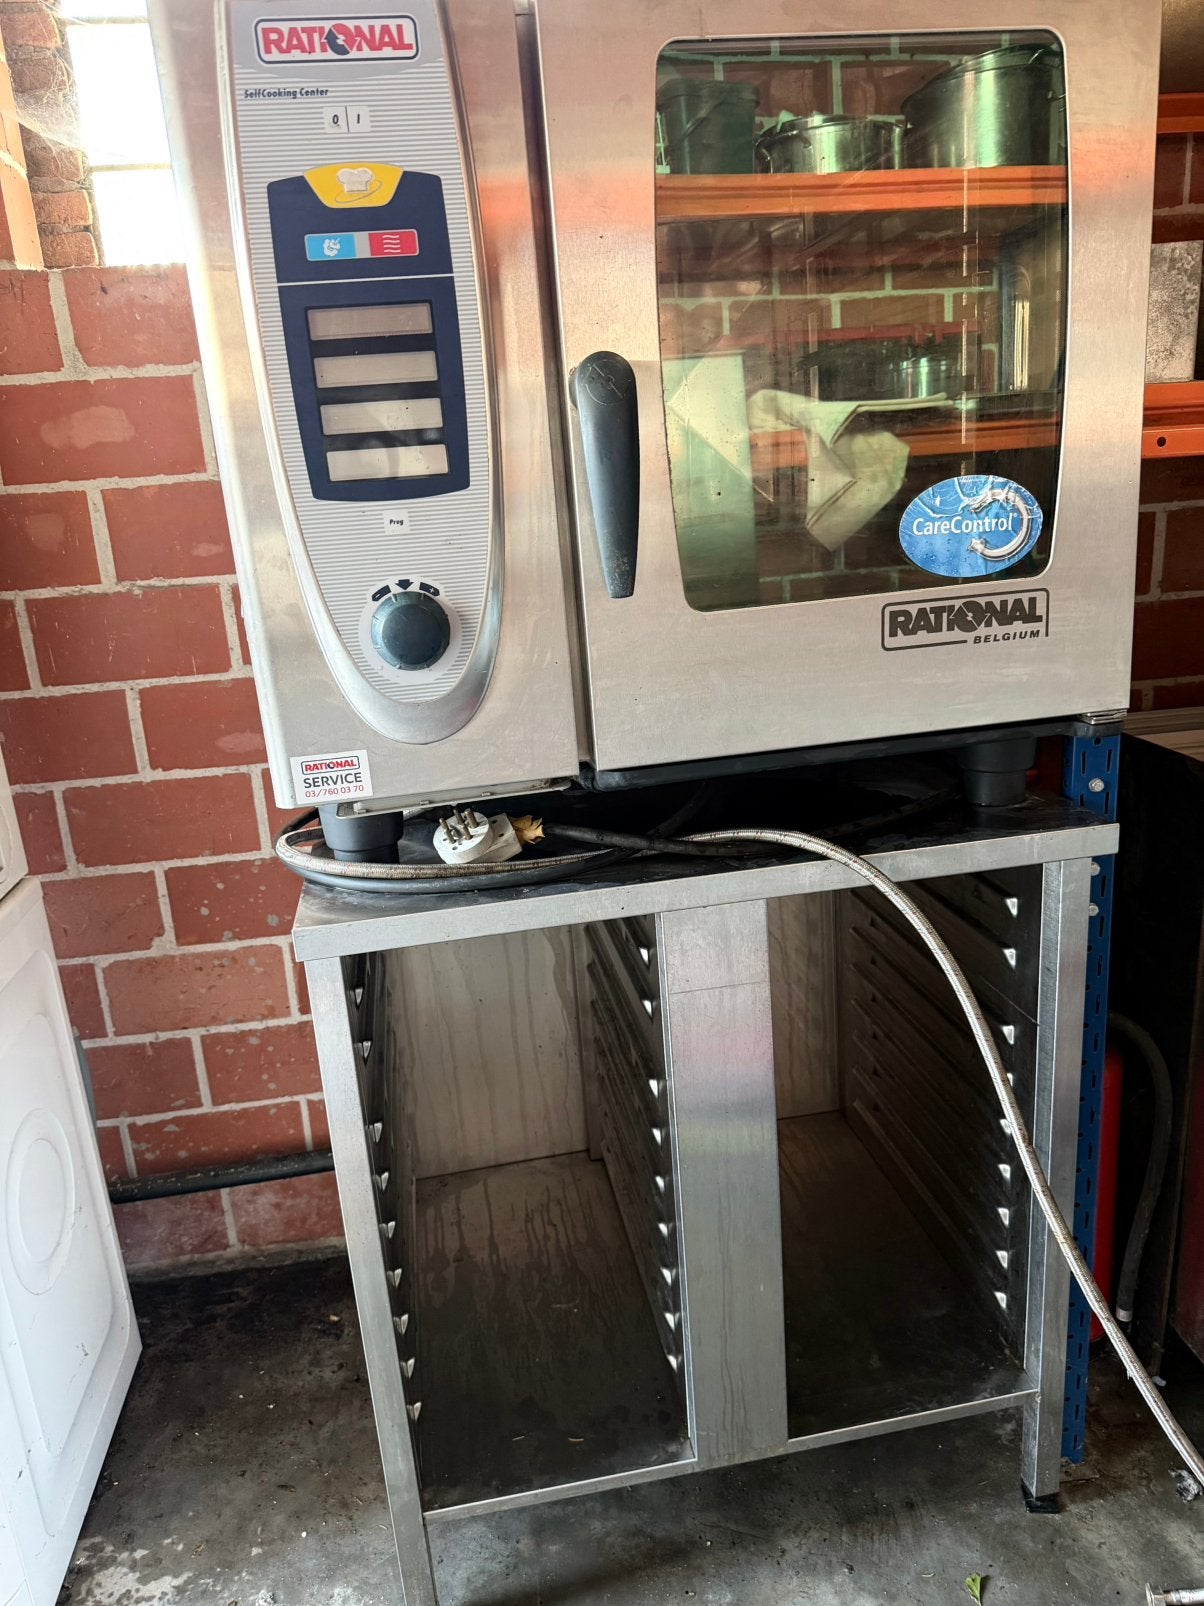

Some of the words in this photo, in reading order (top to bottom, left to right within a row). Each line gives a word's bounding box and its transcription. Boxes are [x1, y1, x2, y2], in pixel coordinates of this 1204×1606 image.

[261, 23, 414, 55] RATIONAL
[244, 88, 298, 99] SelfCooking
[299, 87, 330, 97] Center
[389, 518, 404, 526] Prog
[888, 596, 1043, 638] RATIONAL
[973, 629, 1041, 645] BELGIUM
[304, 759, 357, 772] RATIONAL
[303, 772, 363, 789] SERVICE
[304, 787, 339, 798] 03/760
[340, 786, 352, 794] 03
[353, 784, 365, 792] 70
